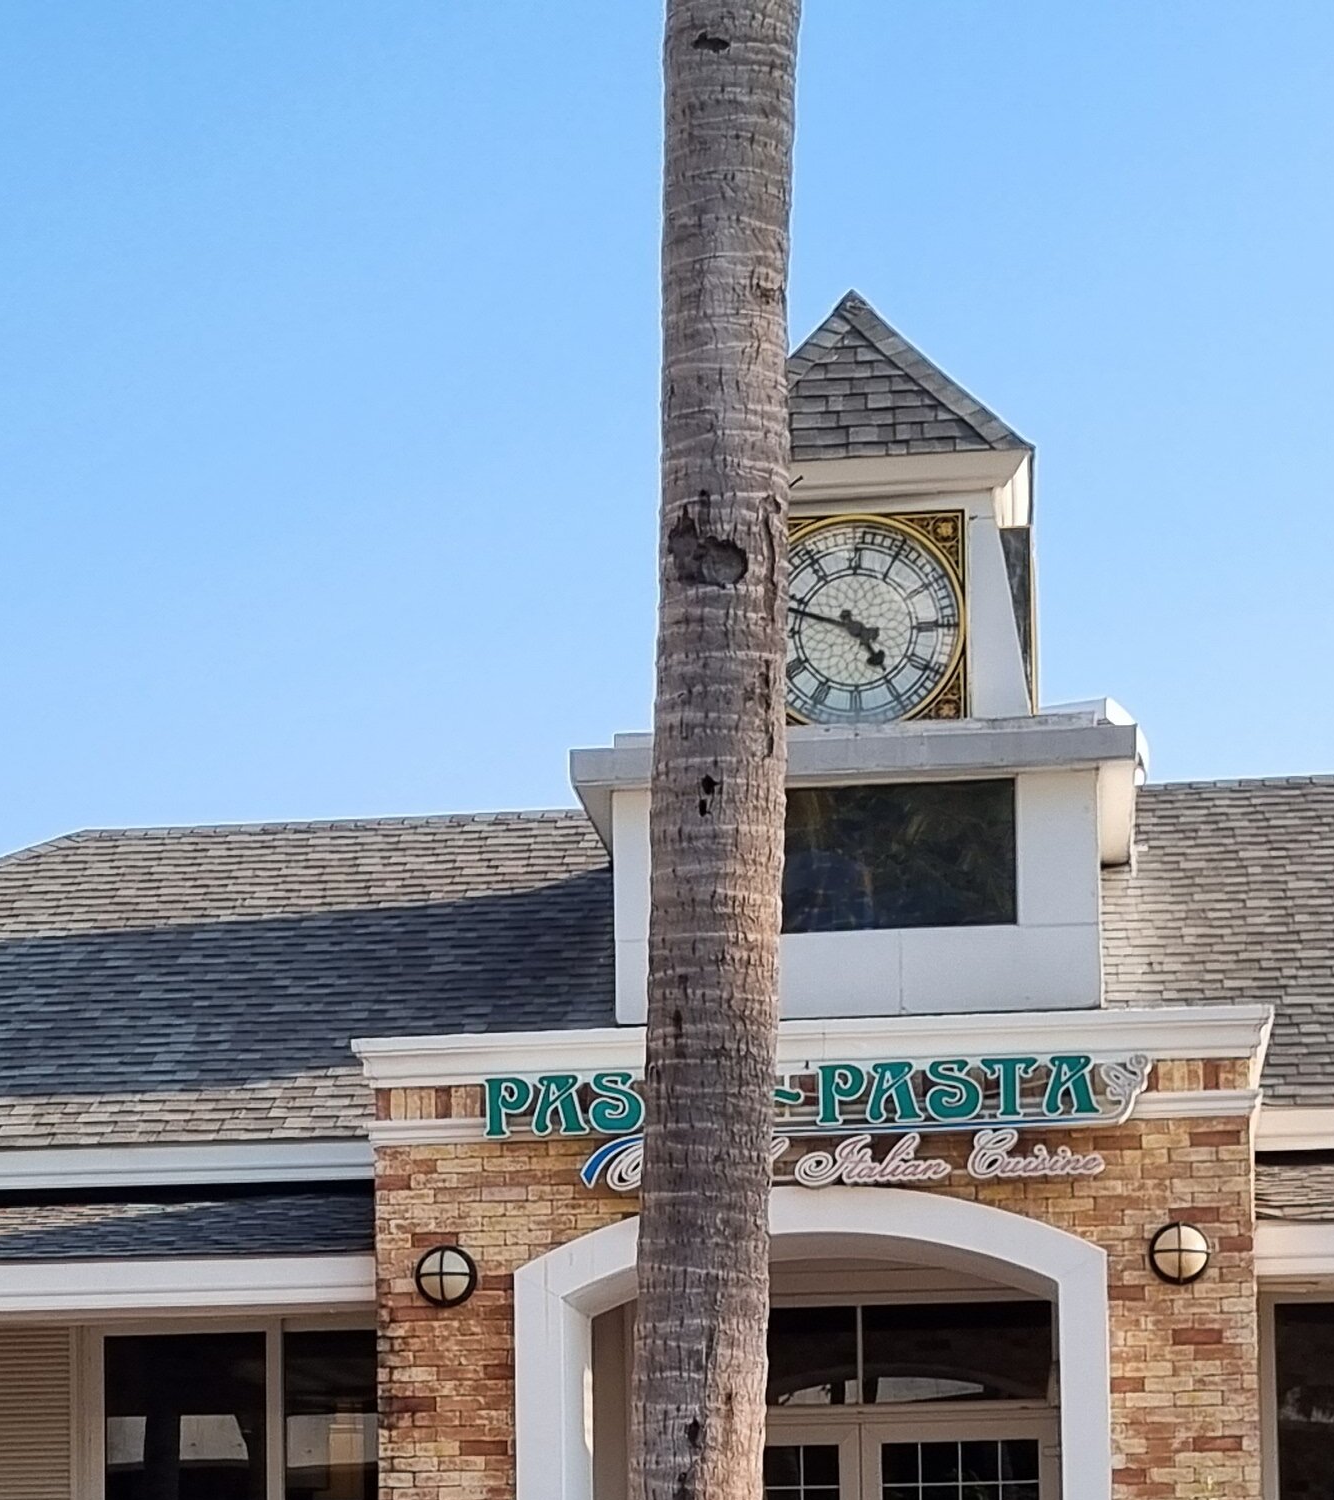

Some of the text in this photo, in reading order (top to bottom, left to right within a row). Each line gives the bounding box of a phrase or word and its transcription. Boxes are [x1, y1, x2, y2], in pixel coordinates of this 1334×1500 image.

[484, 1072, 645, 1138] PAS
[816, 1055, 1101, 1126] PASTA
[795, 1133, 952, 1187] Italian
[968, 1128, 1105, 1179] Cuisine
